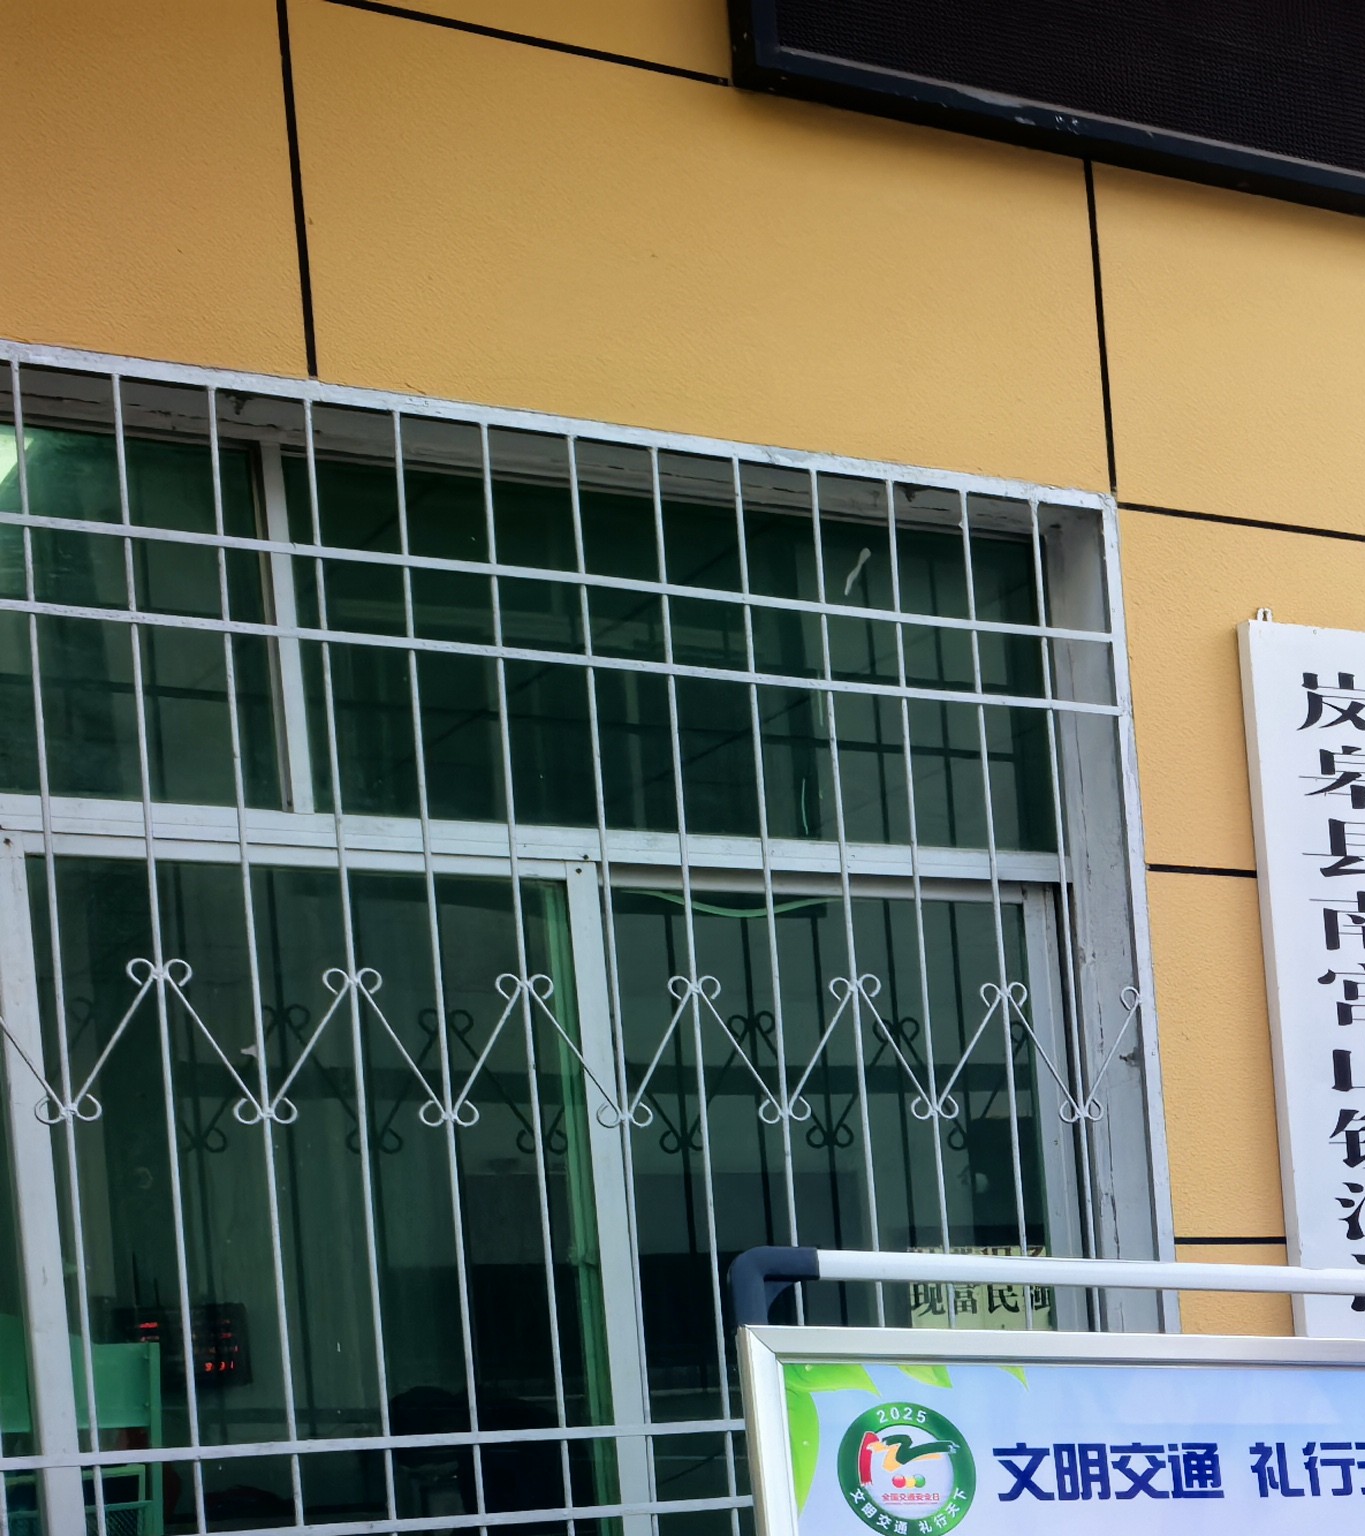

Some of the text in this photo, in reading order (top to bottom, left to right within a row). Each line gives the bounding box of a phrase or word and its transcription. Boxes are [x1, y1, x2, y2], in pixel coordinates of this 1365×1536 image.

[877, 1407, 927, 1424] 2025
[993, 1442, 1225, 1500] 文明交通
[850, 1486, 968, 1536] 文明交通 礼行天下
